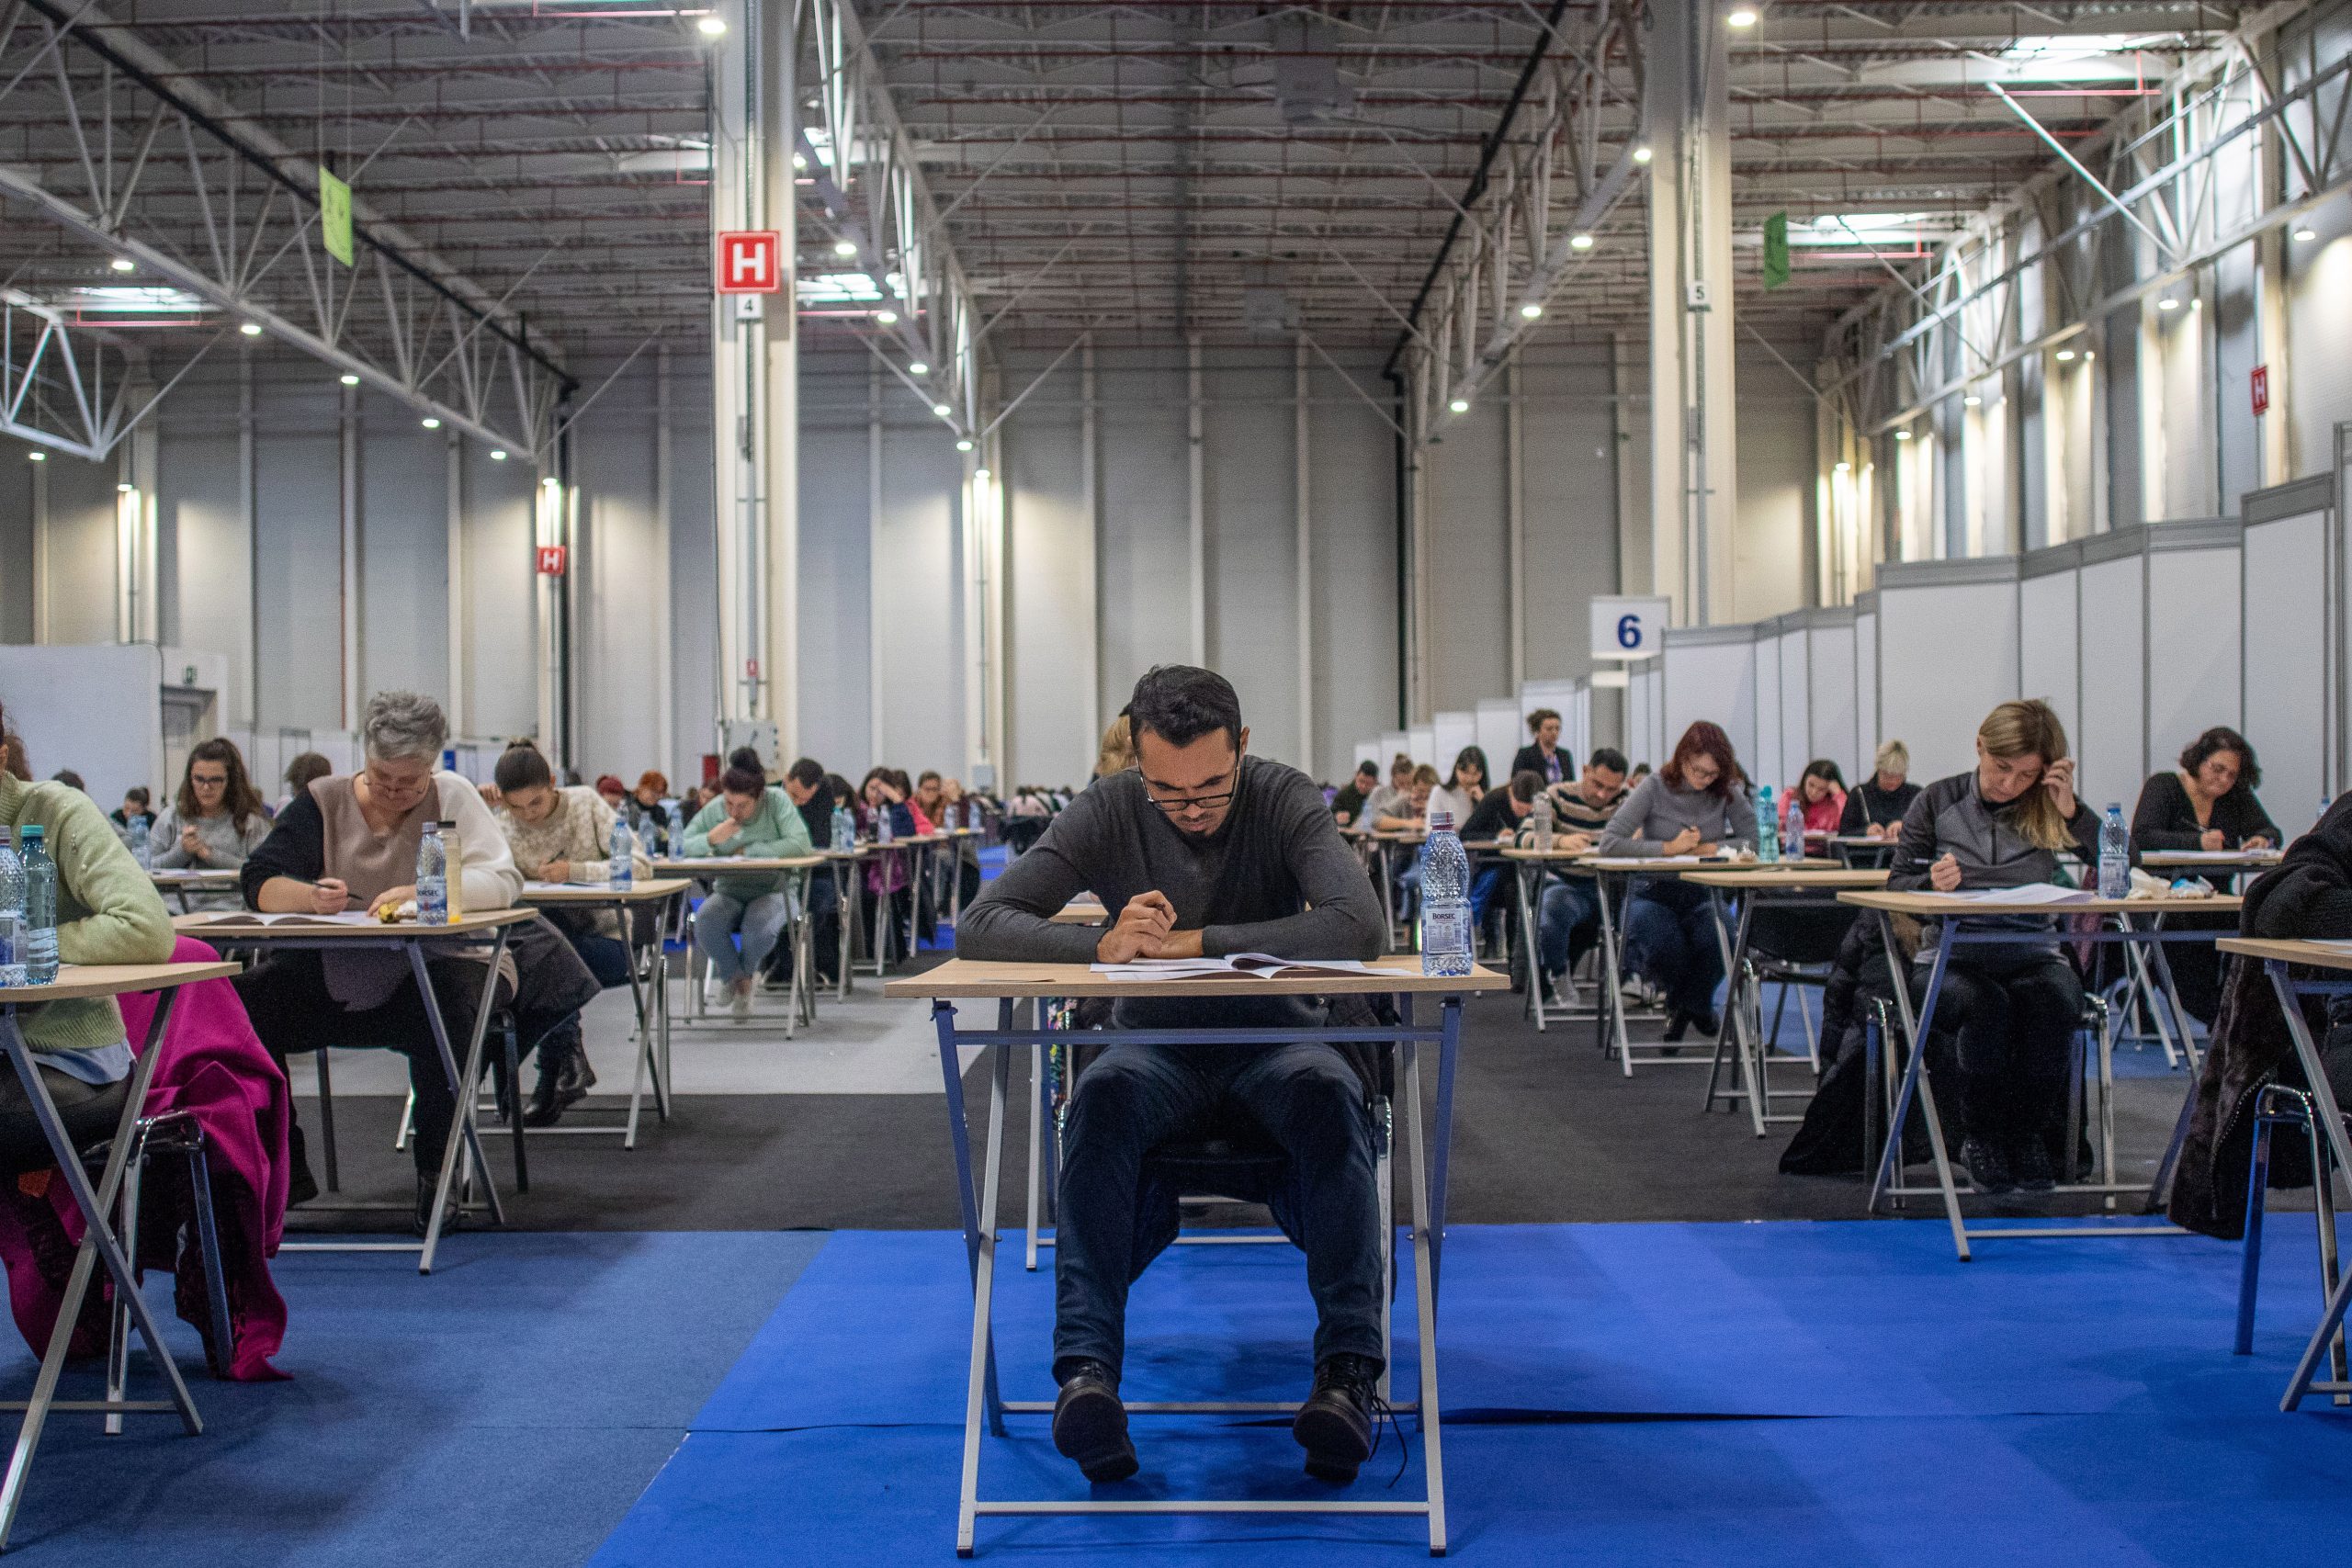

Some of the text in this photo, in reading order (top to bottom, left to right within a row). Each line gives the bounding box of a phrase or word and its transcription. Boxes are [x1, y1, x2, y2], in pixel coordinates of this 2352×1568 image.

[732, 243, 765, 282] H
[744, 298, 753, 311] 4
[1696, 286, 1705, 299] 5
[2255, 374, 2267, 407] H
[543, 551, 560, 570] H
[1617, 614, 1643, 649] 6
